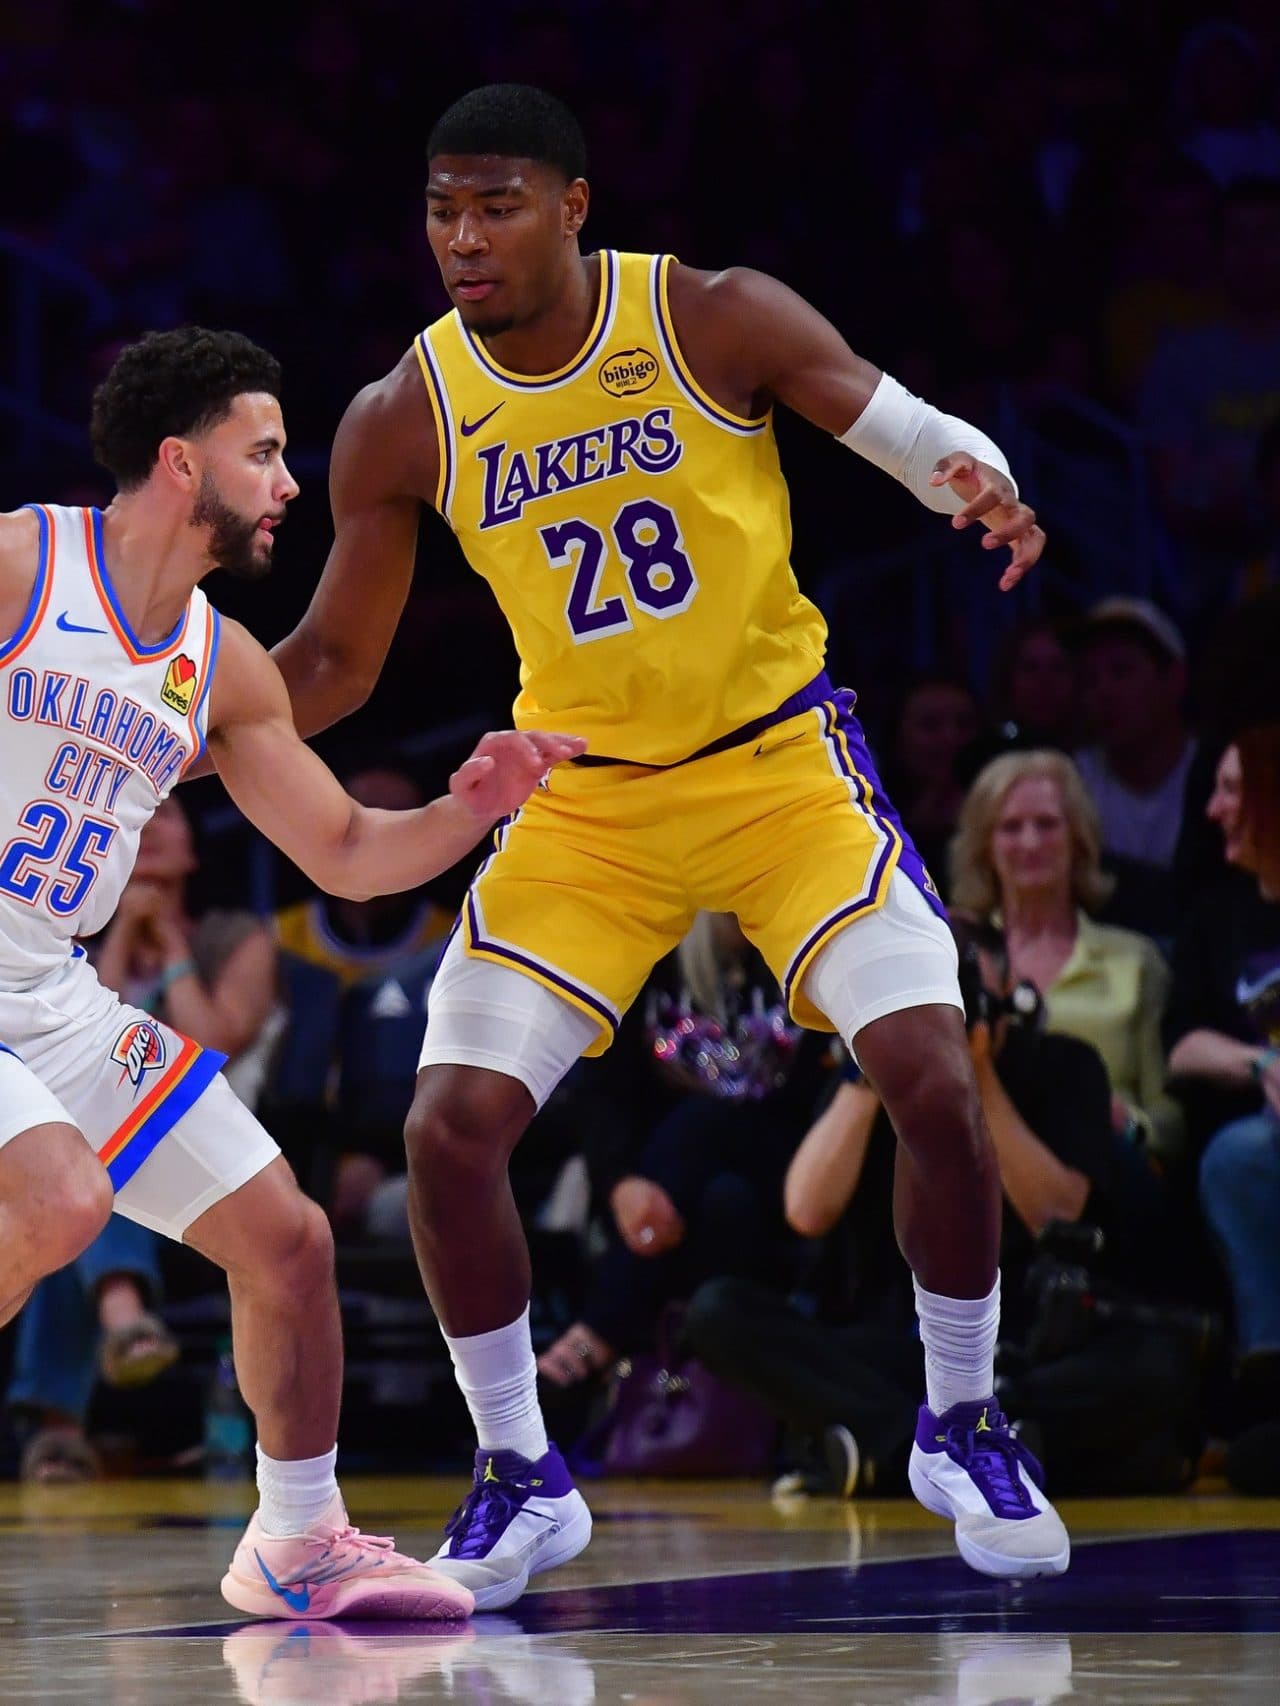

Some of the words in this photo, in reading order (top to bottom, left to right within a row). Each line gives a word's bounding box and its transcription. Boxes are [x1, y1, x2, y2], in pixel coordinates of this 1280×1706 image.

[603, 361, 655, 384] bibigo
[477, 406, 683, 531] LAKERS
[537, 497, 699, 646] 28
[8, 667, 187, 796] OKLAHOMA
[45, 741, 134, 815] CITY
